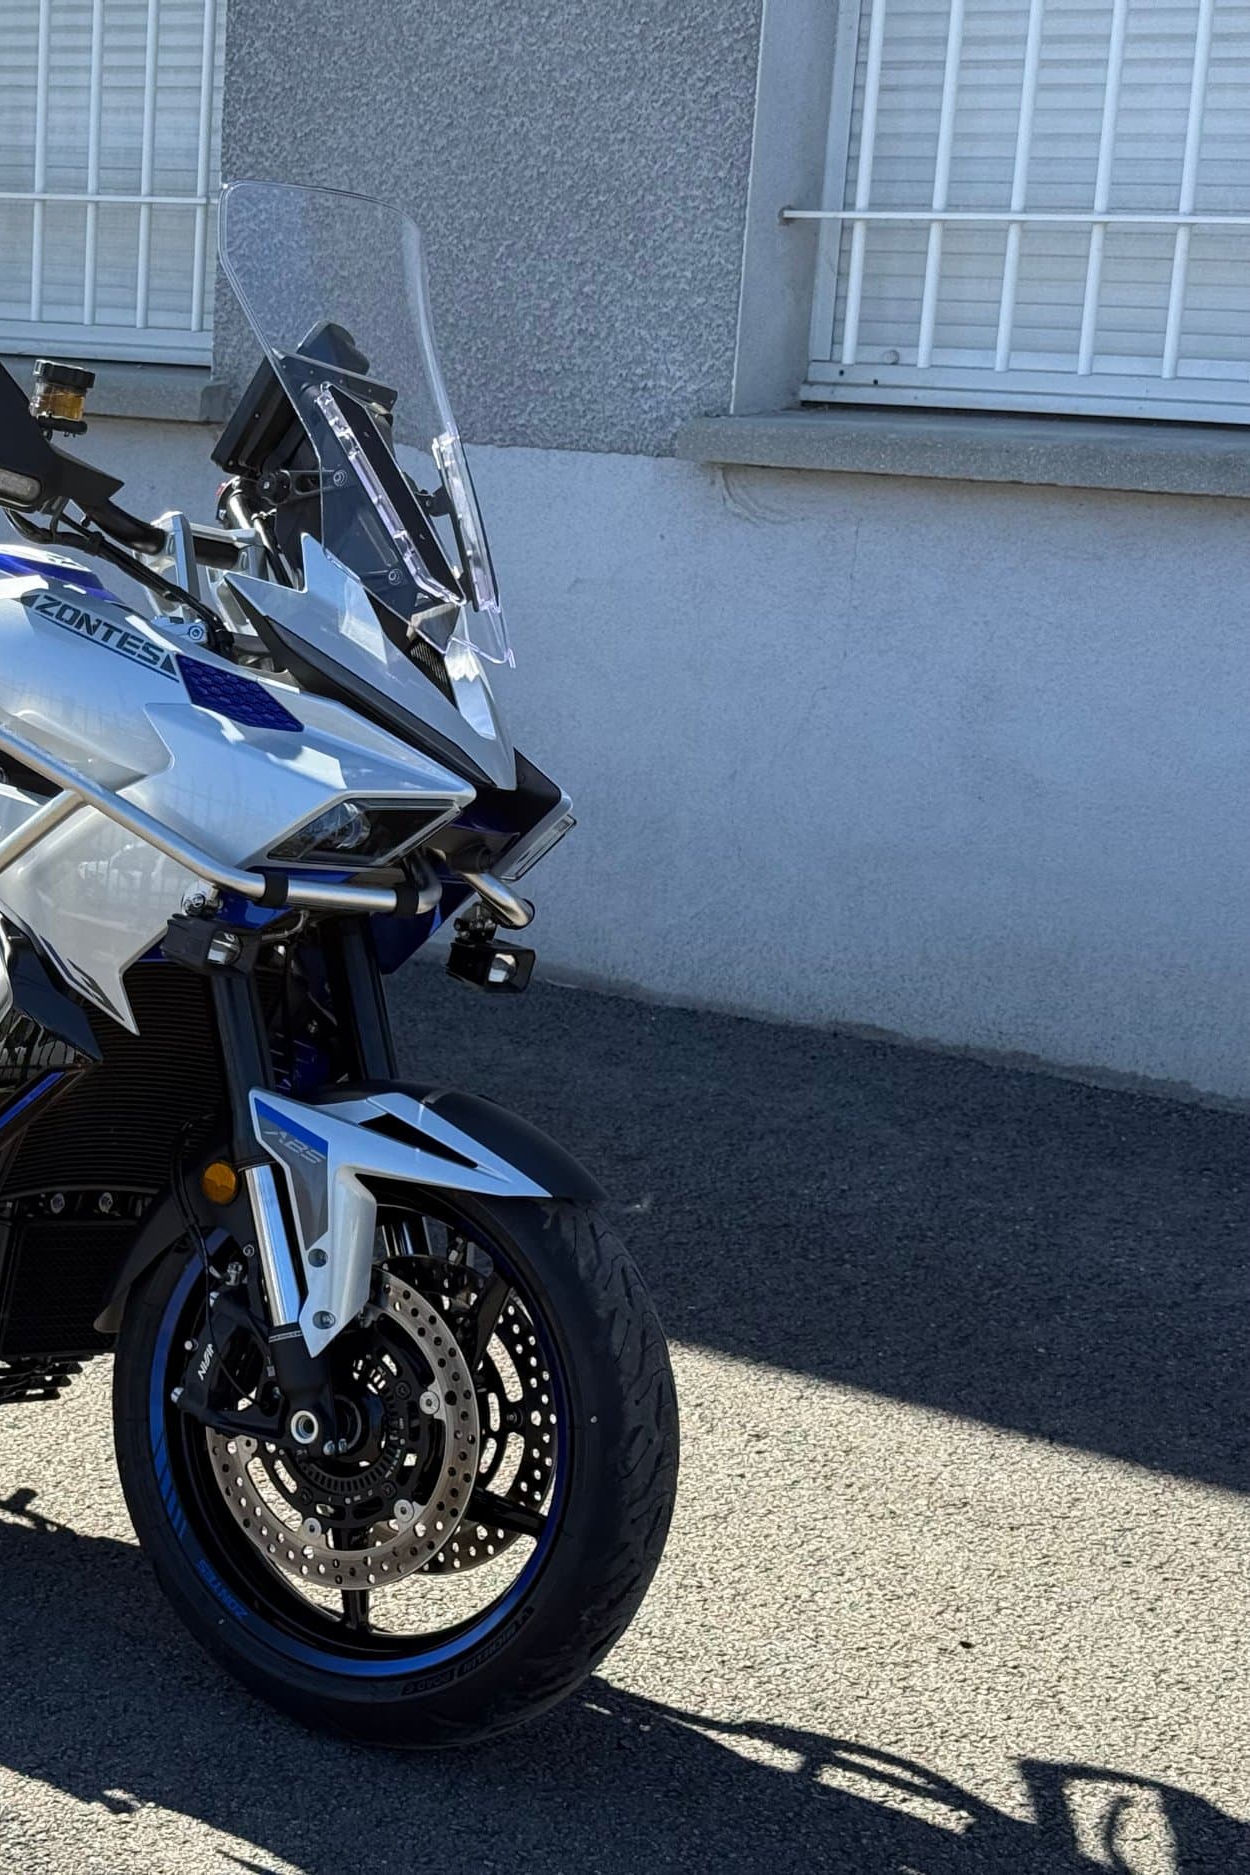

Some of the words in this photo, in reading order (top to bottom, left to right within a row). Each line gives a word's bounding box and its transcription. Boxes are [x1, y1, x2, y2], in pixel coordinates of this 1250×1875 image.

[35, 594, 165, 667] ZONTES
[262, 1130, 326, 1164] ABS
[196, 1559, 248, 1618] ZONTES
[462, 1623, 517, 1674] MICHELIN
